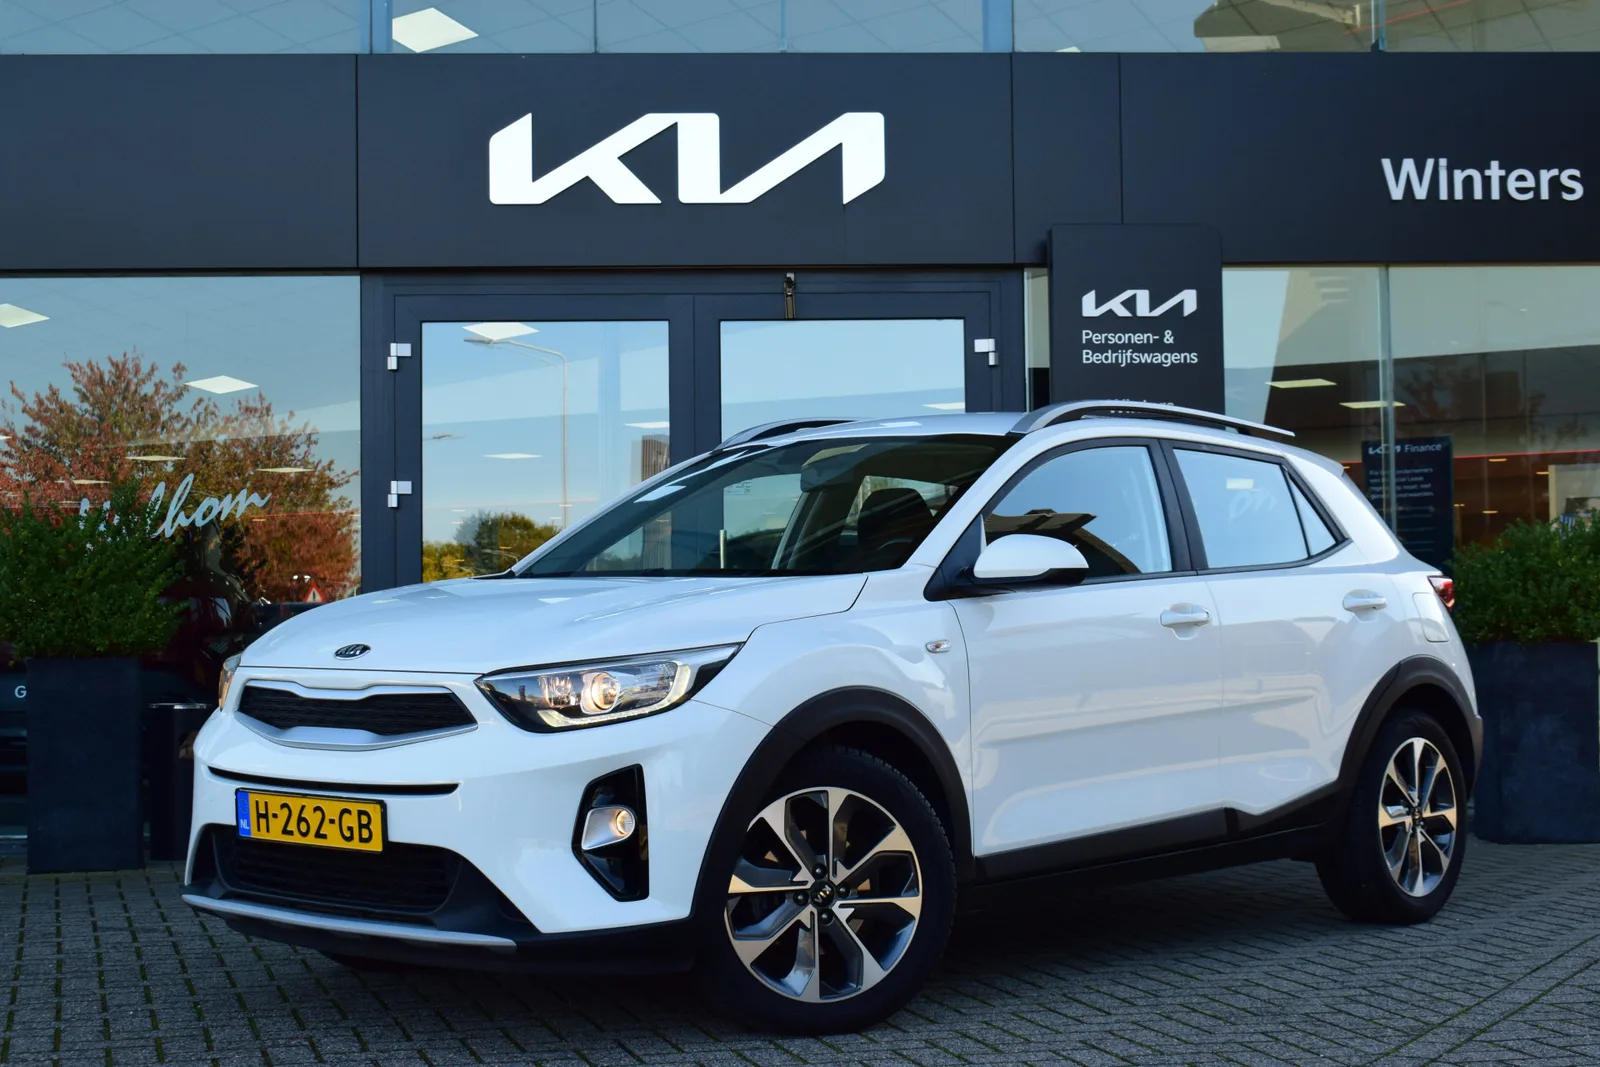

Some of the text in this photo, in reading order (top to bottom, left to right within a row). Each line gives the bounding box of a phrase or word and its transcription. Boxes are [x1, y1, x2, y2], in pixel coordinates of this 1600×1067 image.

[489, 112, 886, 205] KIA
[1381, 158, 1584, 201] Winters
[1082, 289, 1197, 317] KIA
[1082, 329, 1174, 344] Personen- &
[1082, 349, 1198, 367] Bedrijfswagens
[1404, 443, 1442, 453] Finance
[240, 800, 374, 843] NL H-262-GB
